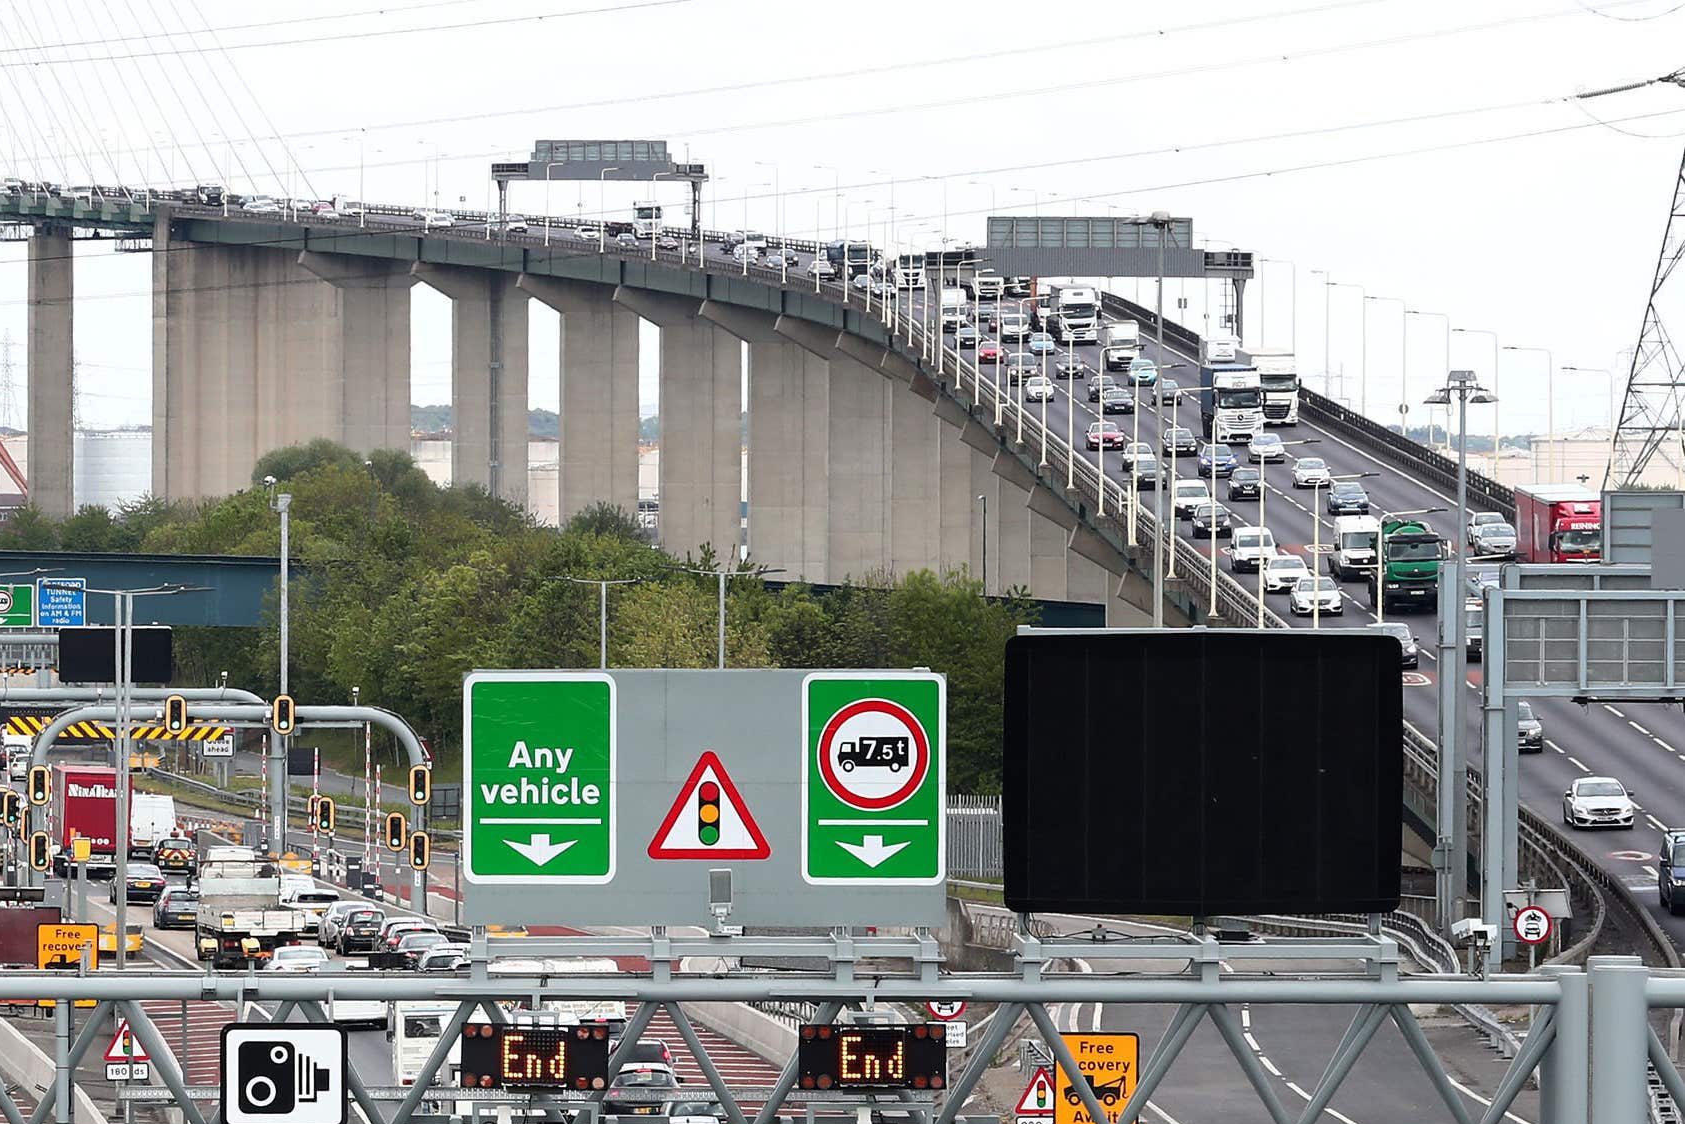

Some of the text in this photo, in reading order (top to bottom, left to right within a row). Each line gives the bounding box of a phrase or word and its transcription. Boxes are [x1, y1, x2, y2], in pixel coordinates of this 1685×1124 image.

[508, 741, 574, 774] Any
[481, 777, 600, 805] vehicle
[56, 929, 81, 939] Free
[502, 1034, 566, 1080] End
[1080, 1041, 1114, 1053] Free
[840, 1035, 904, 1080] End
[1078, 1061, 1130, 1073] covery
[1073, 1111, 1119, 1123] Awit
